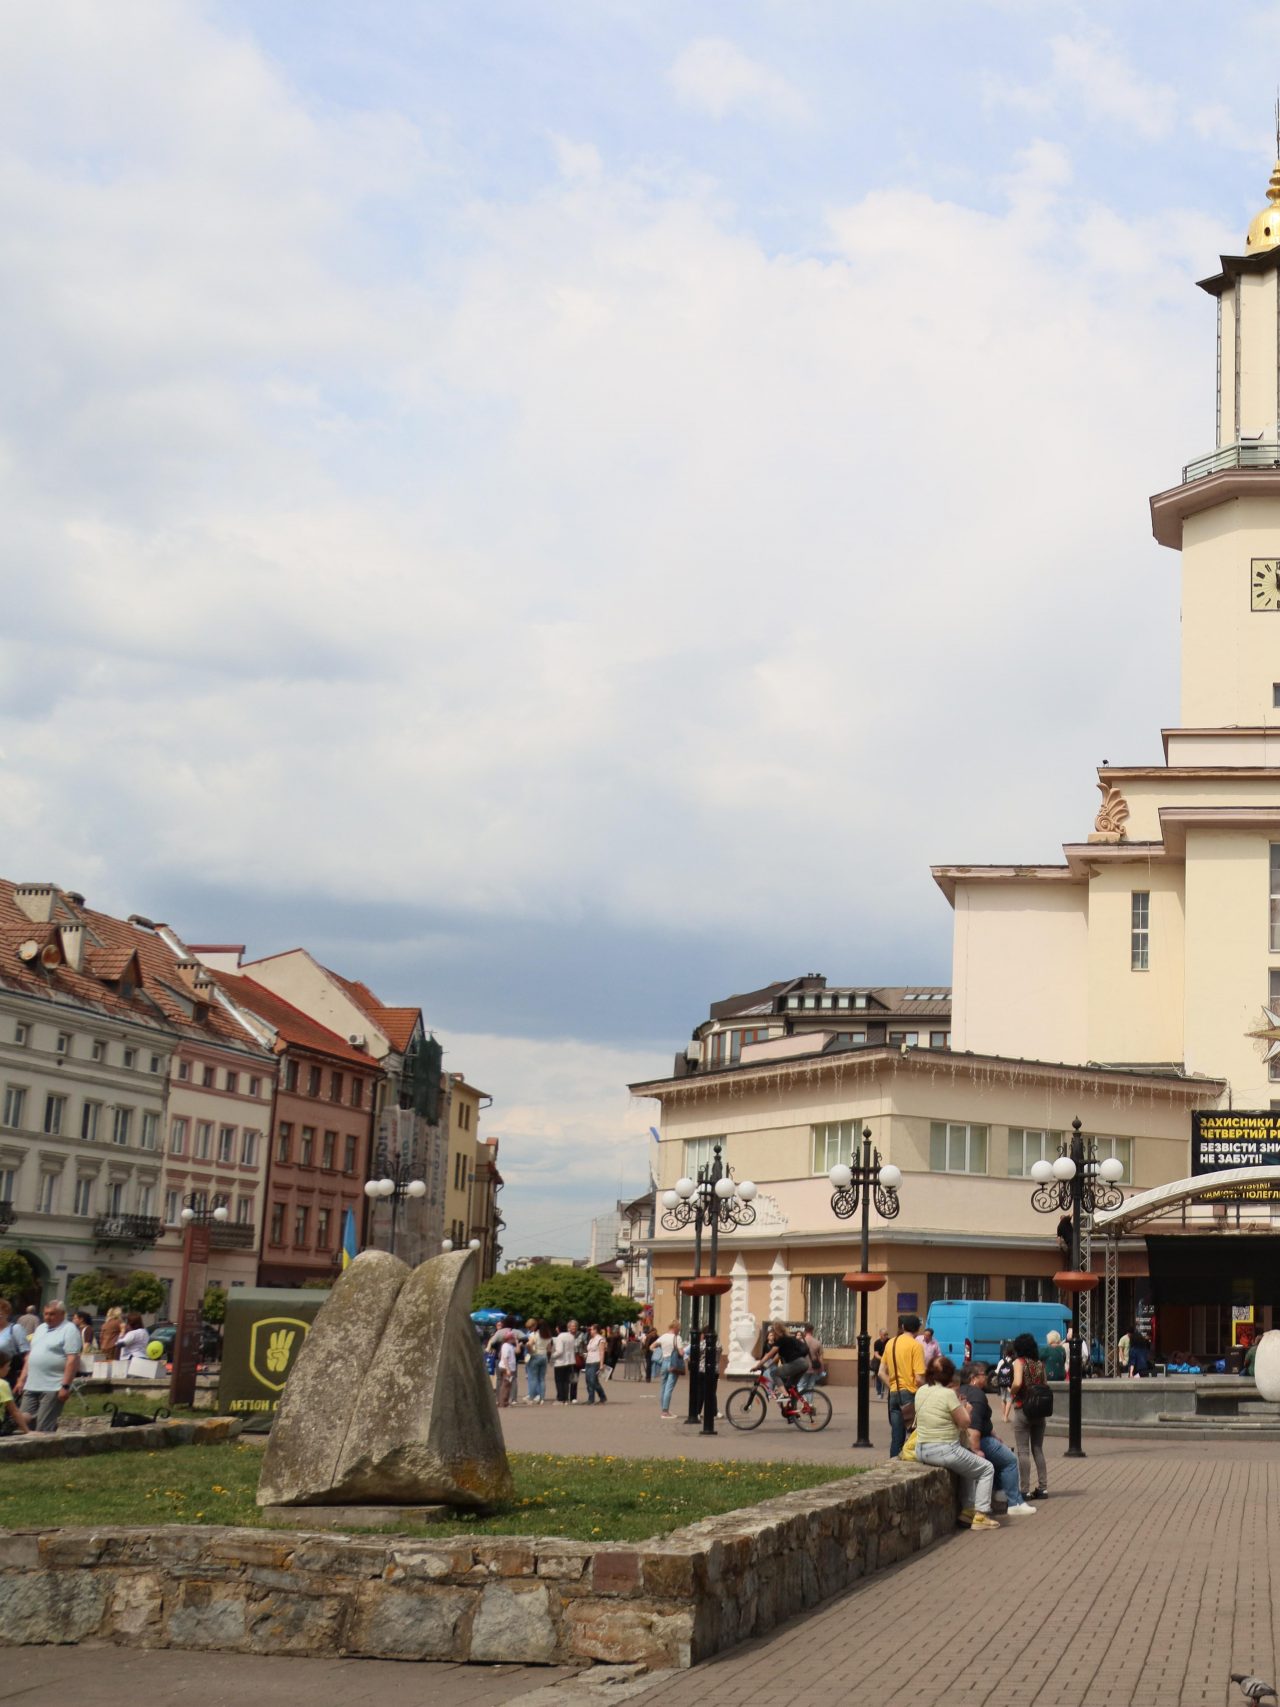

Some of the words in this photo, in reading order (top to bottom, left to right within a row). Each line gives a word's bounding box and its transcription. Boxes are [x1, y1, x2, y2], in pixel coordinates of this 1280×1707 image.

[1200, 1117, 1274, 1128] ЗАХИСНИКИ
[1200, 1128, 1267, 1138] ЧЕТВЕРТИЙ
[1200, 1143, 1257, 1152] БЕЗВІСТИ
[1200, 1154, 1215, 1163] НЕ
[1217, 1154, 1263, 1163] ЗАБУТІ!
